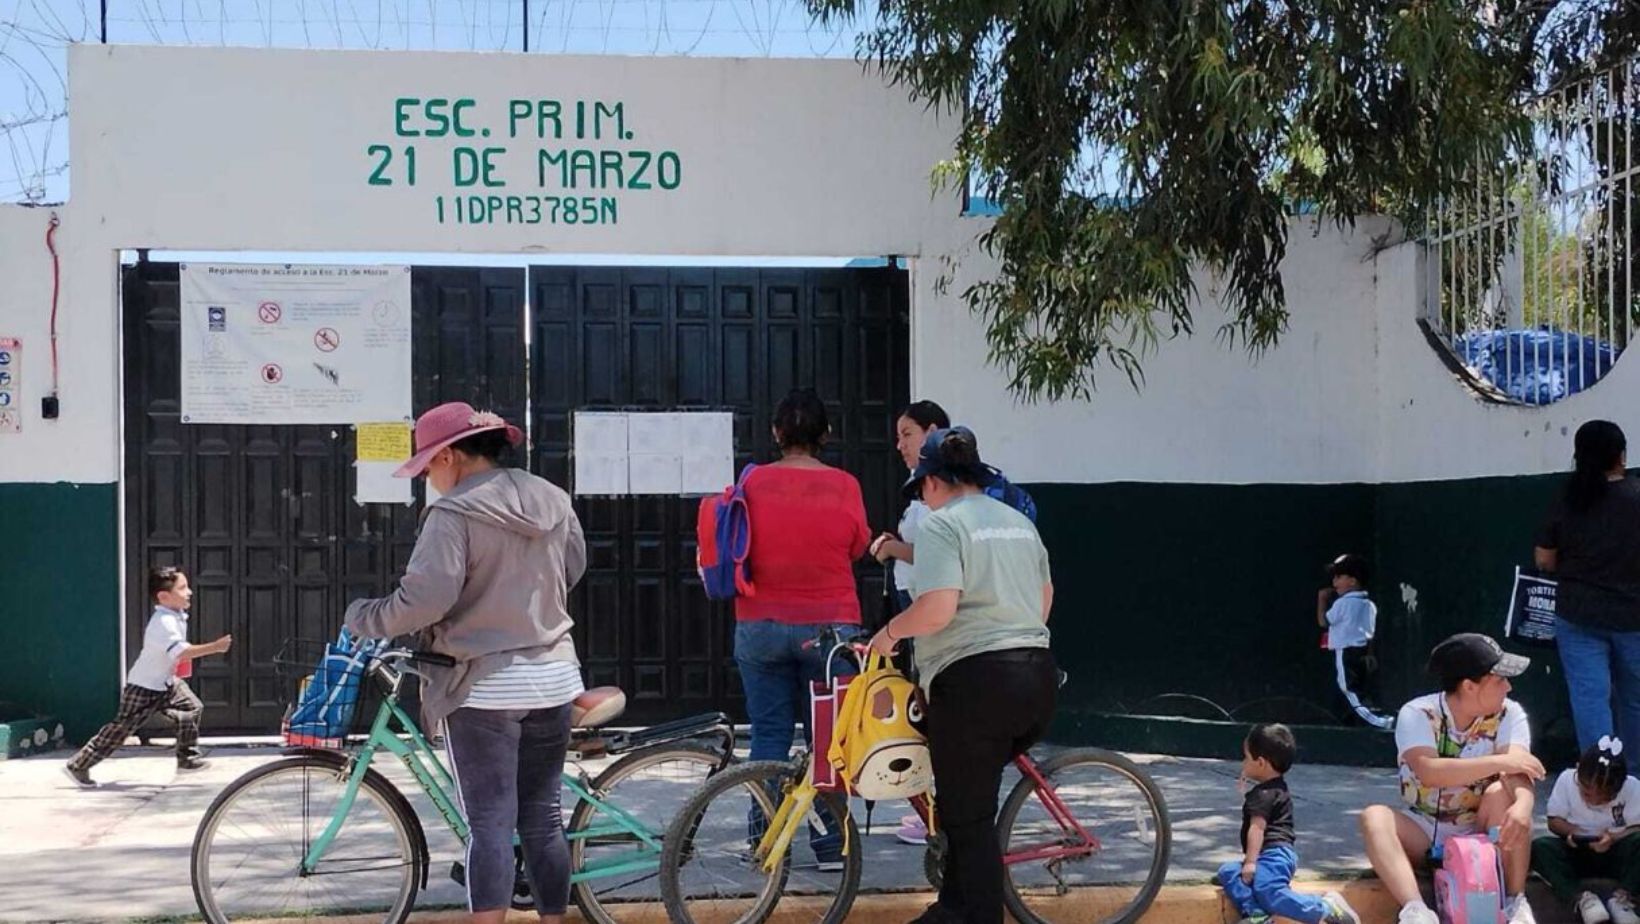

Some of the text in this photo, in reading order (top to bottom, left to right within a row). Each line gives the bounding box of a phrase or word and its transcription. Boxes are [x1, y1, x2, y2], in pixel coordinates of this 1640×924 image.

[395, 98, 634, 140] ESC. PRIM.
[367, 145, 681, 190] 21 DE MARZO
[435, 196, 618, 225] 11DPR3785N
